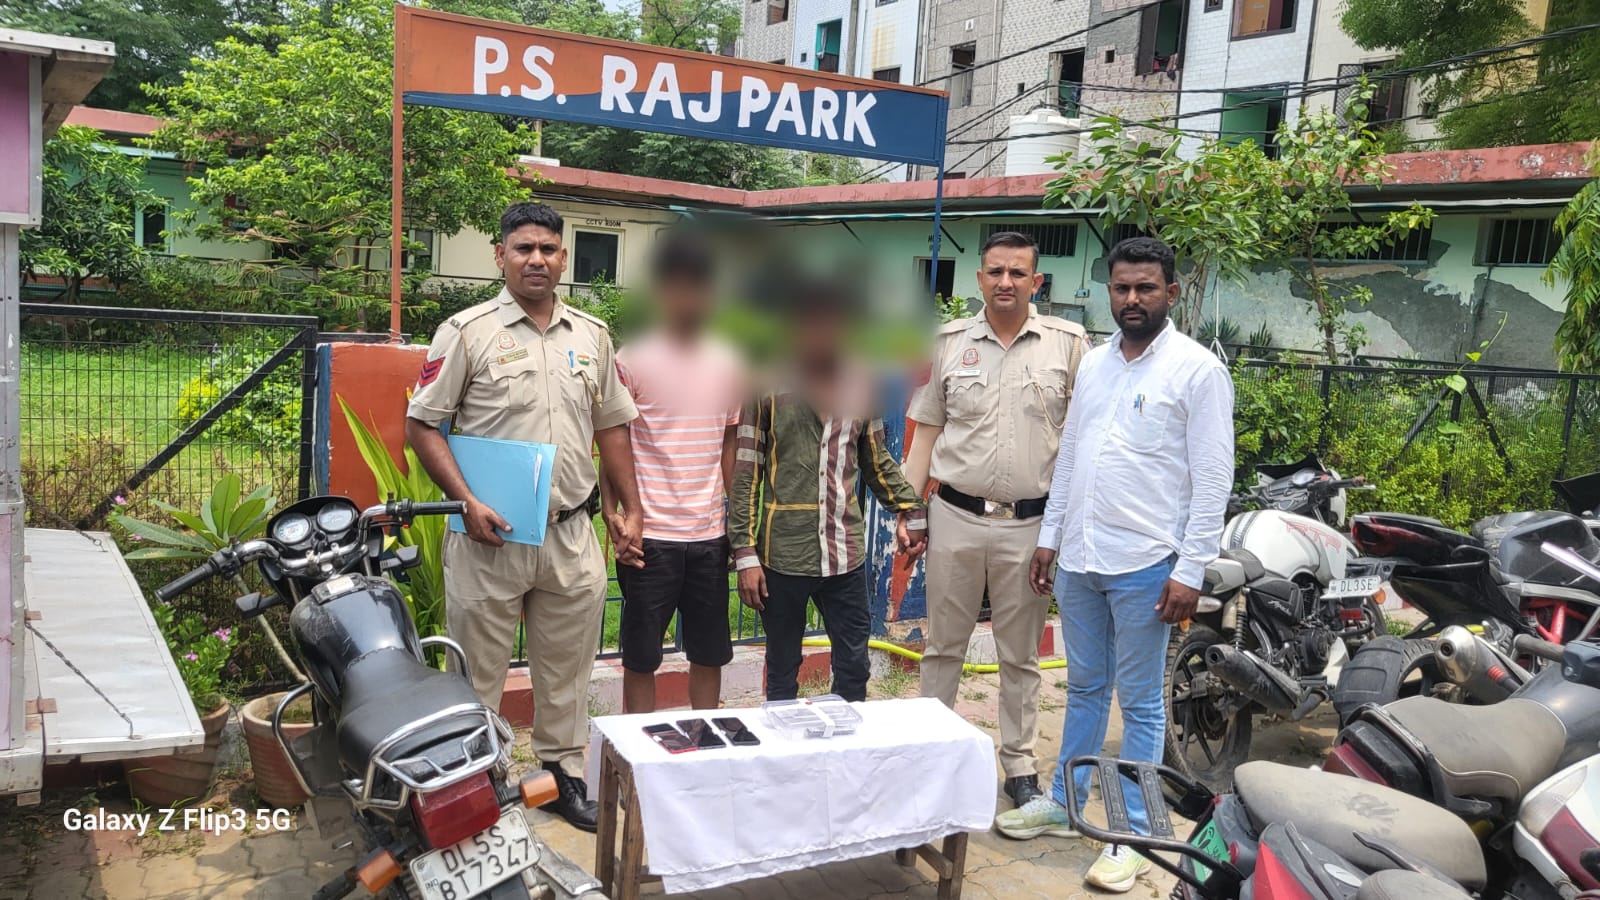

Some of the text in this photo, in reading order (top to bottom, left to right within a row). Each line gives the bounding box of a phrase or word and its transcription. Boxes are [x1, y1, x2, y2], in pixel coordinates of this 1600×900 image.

[473, 35, 878, 148] P.S. RAJ PARK
[585, 217, 621, 227] CCTV ROOM
[1340, 578, 1374, 592] DL3SE
